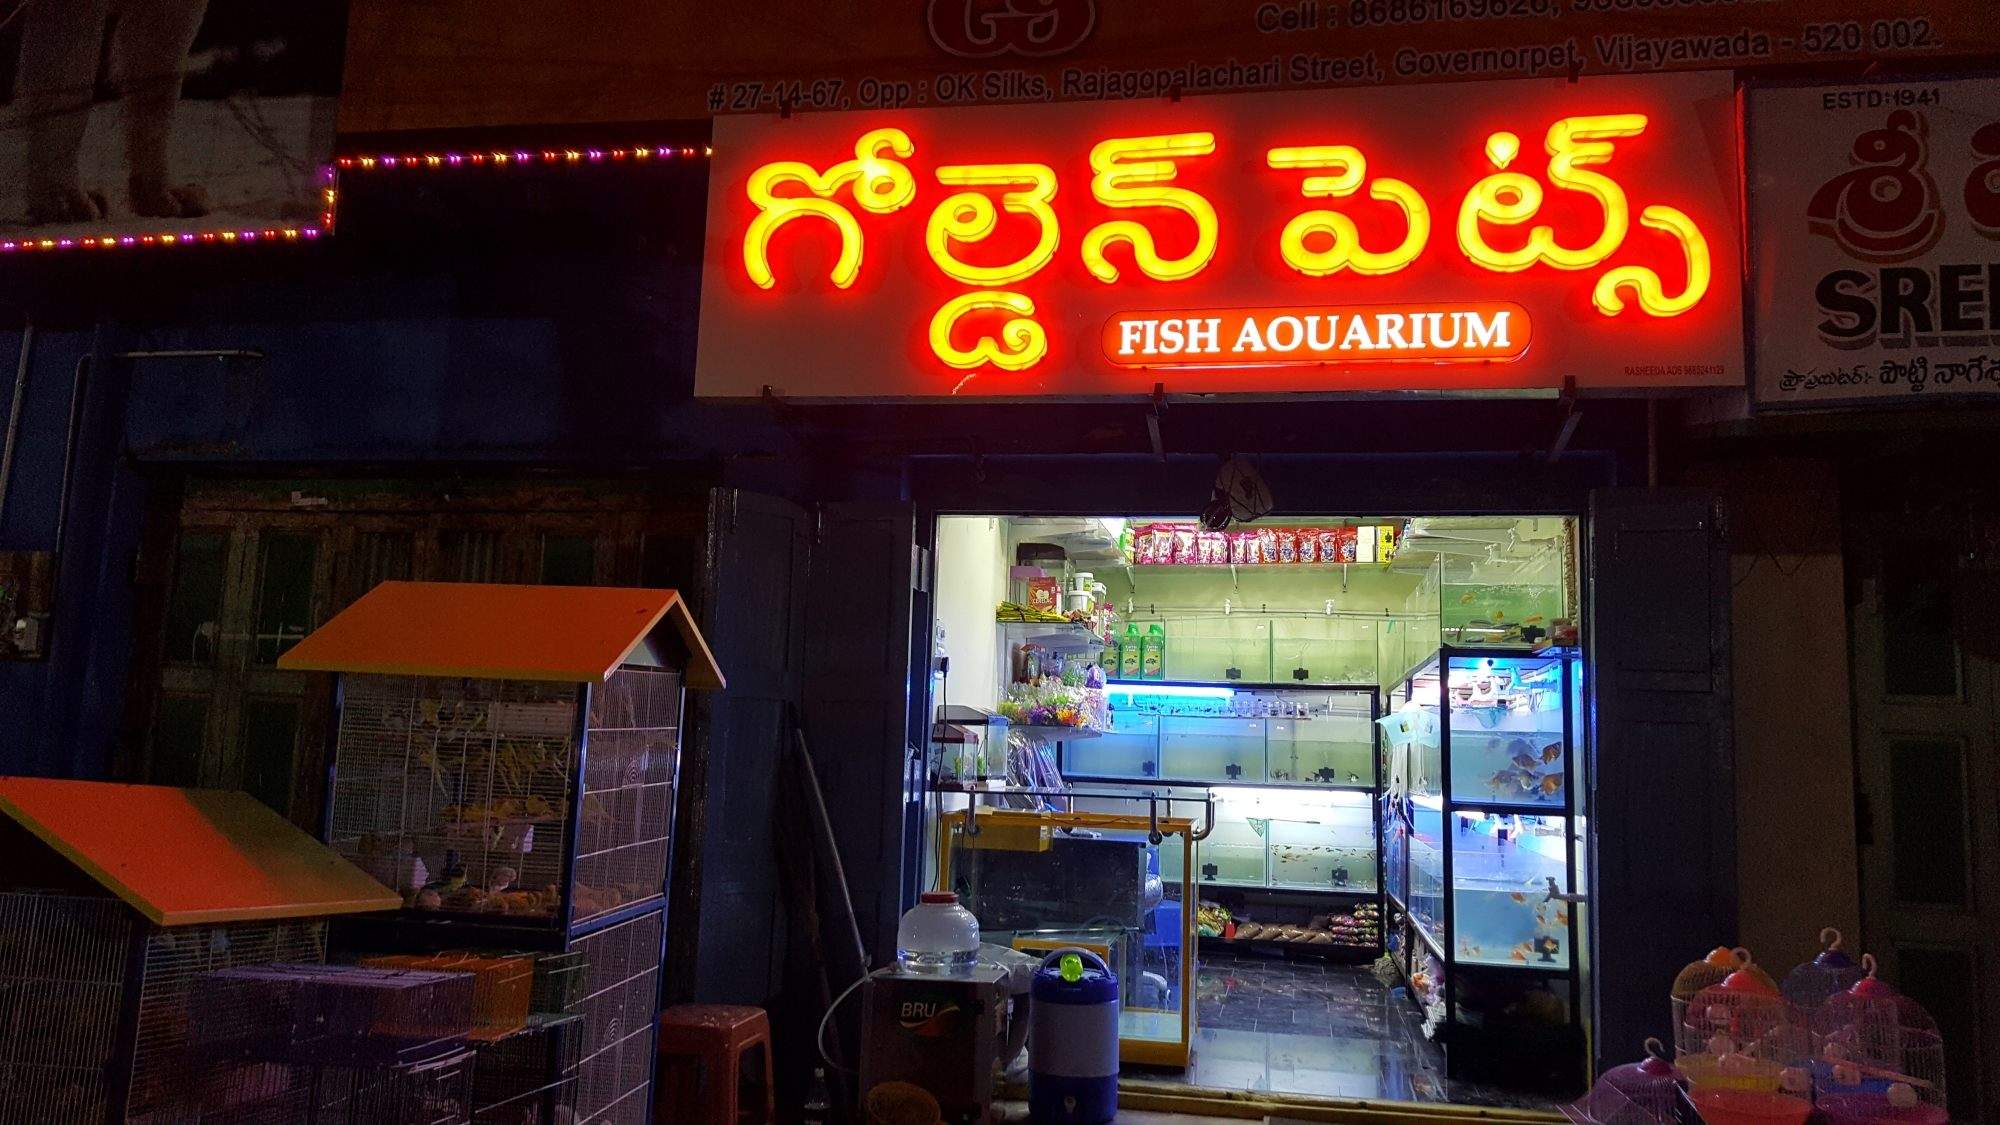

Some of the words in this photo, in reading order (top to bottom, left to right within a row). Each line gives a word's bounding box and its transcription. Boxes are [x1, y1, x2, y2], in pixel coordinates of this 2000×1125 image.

[1257, 4, 1316, 31] Cell
[707, 84, 725, 109] #
[859, 77, 910, 106] Opp
[937, 73, 977, 100] OK
[984, 71, 1053, 101] Silks,
[1063, 57, 1279, 99] Rajagopalachari
[1290, 50, 1382, 81] Street,
[1395, 39, 1584, 77] Governorpet,
[1595, 29, 1769, 69] Vijayawada
[1803, 23, 1861, 52] 520
[1807, 109, 1946, 264] శ్రీ
[742, 126, 1219, 371] గోల్డెన్
[1266, 113, 1711, 317] పెట్స్
[1117, 318, 1221, 355] FISH
[901, 1002, 936, 1018] BRU
